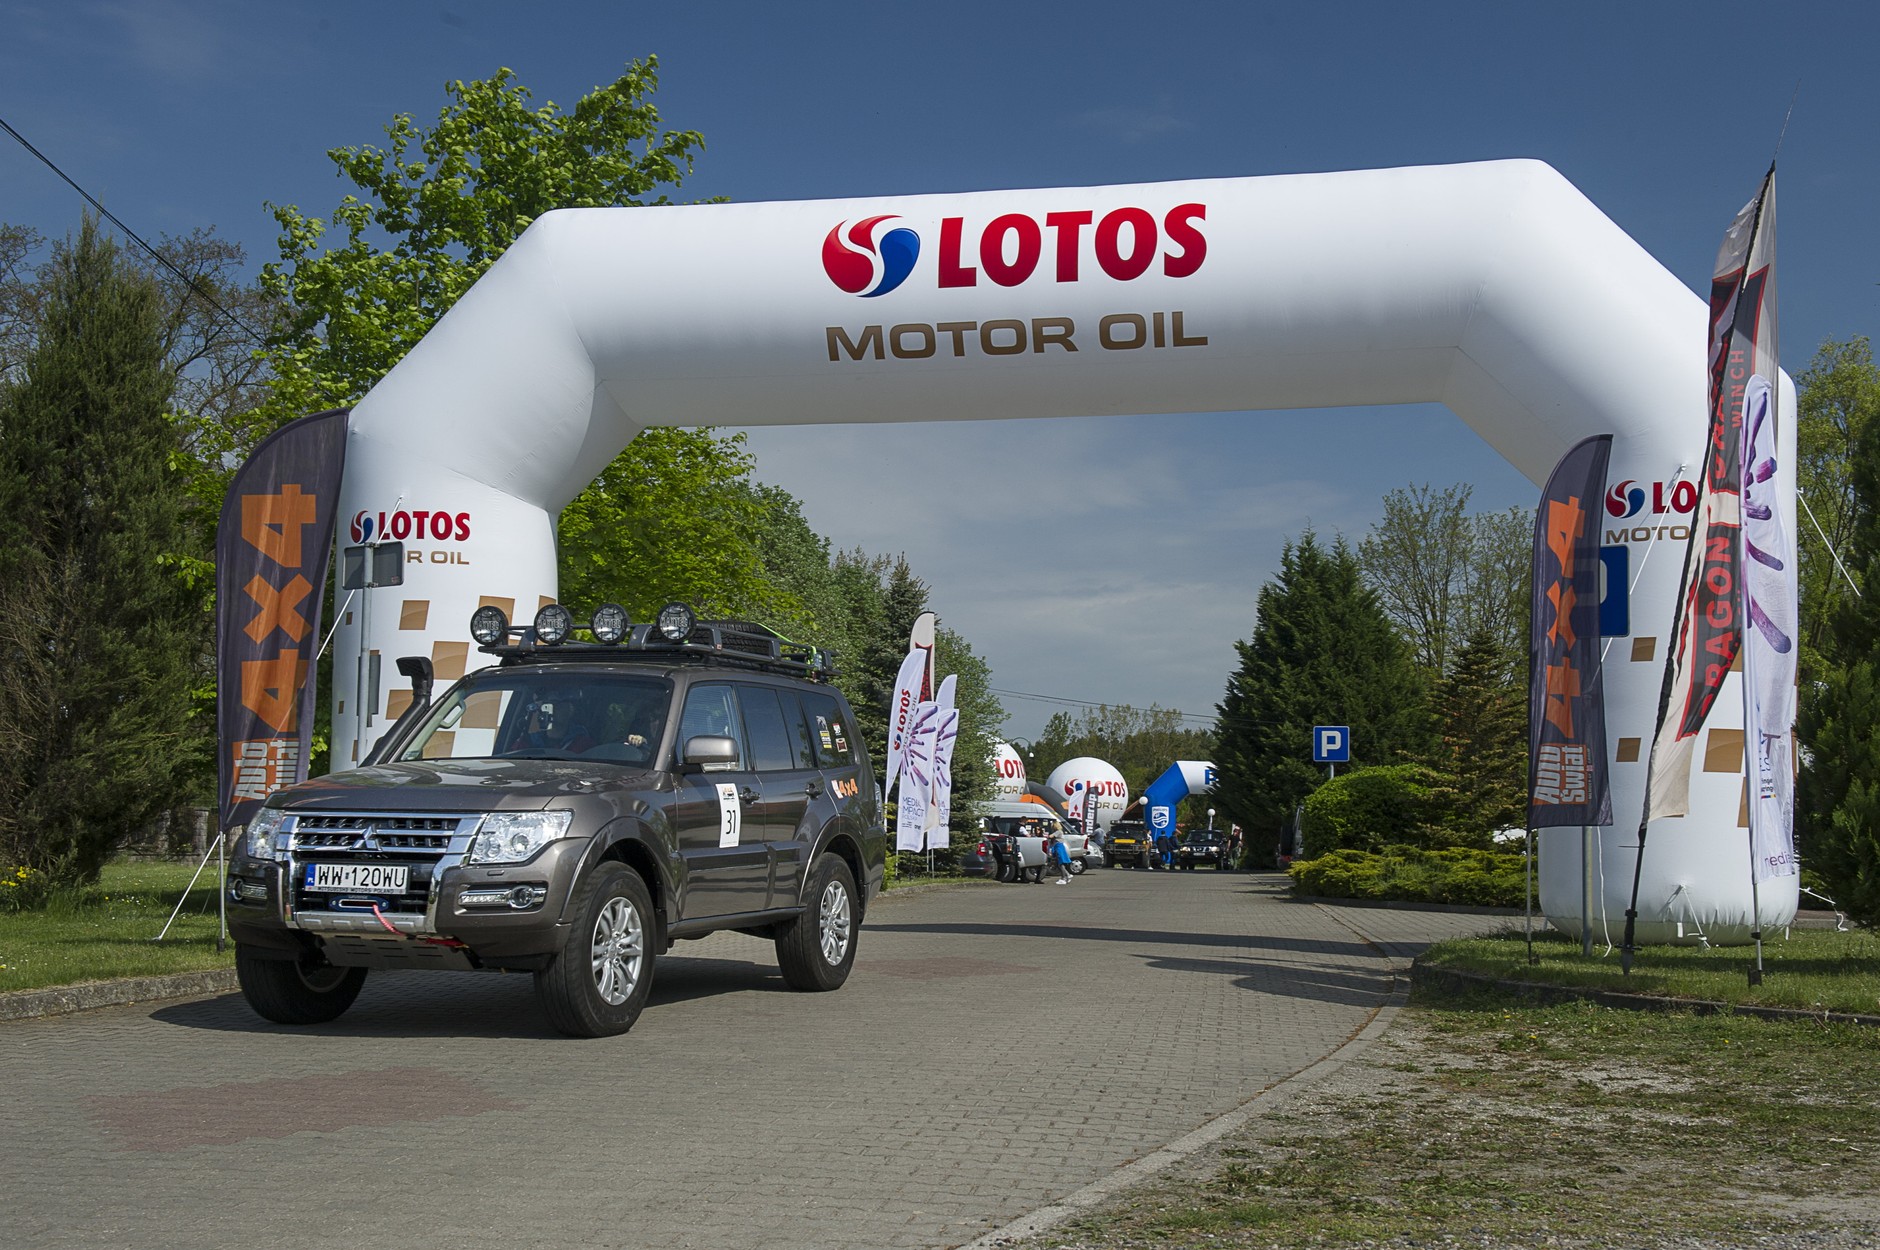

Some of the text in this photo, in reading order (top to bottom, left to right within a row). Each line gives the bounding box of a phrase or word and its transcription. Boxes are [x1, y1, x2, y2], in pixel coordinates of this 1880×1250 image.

[938, 203, 1207, 288] LOTOS
[825, 311, 1208, 362] MOTOR OIL
[1731, 350, 1744, 428] WINCH
[1653, 480, 1700, 514] LO
[378, 510, 470, 541] LOTOS
[431, 551, 469, 564] OIL
[897, 689, 911, 733] LOTOS
[1321, 730, 1341, 757] P
[725, 810, 736, 835] 31
[318, 866, 406, 888] WW 120WU
